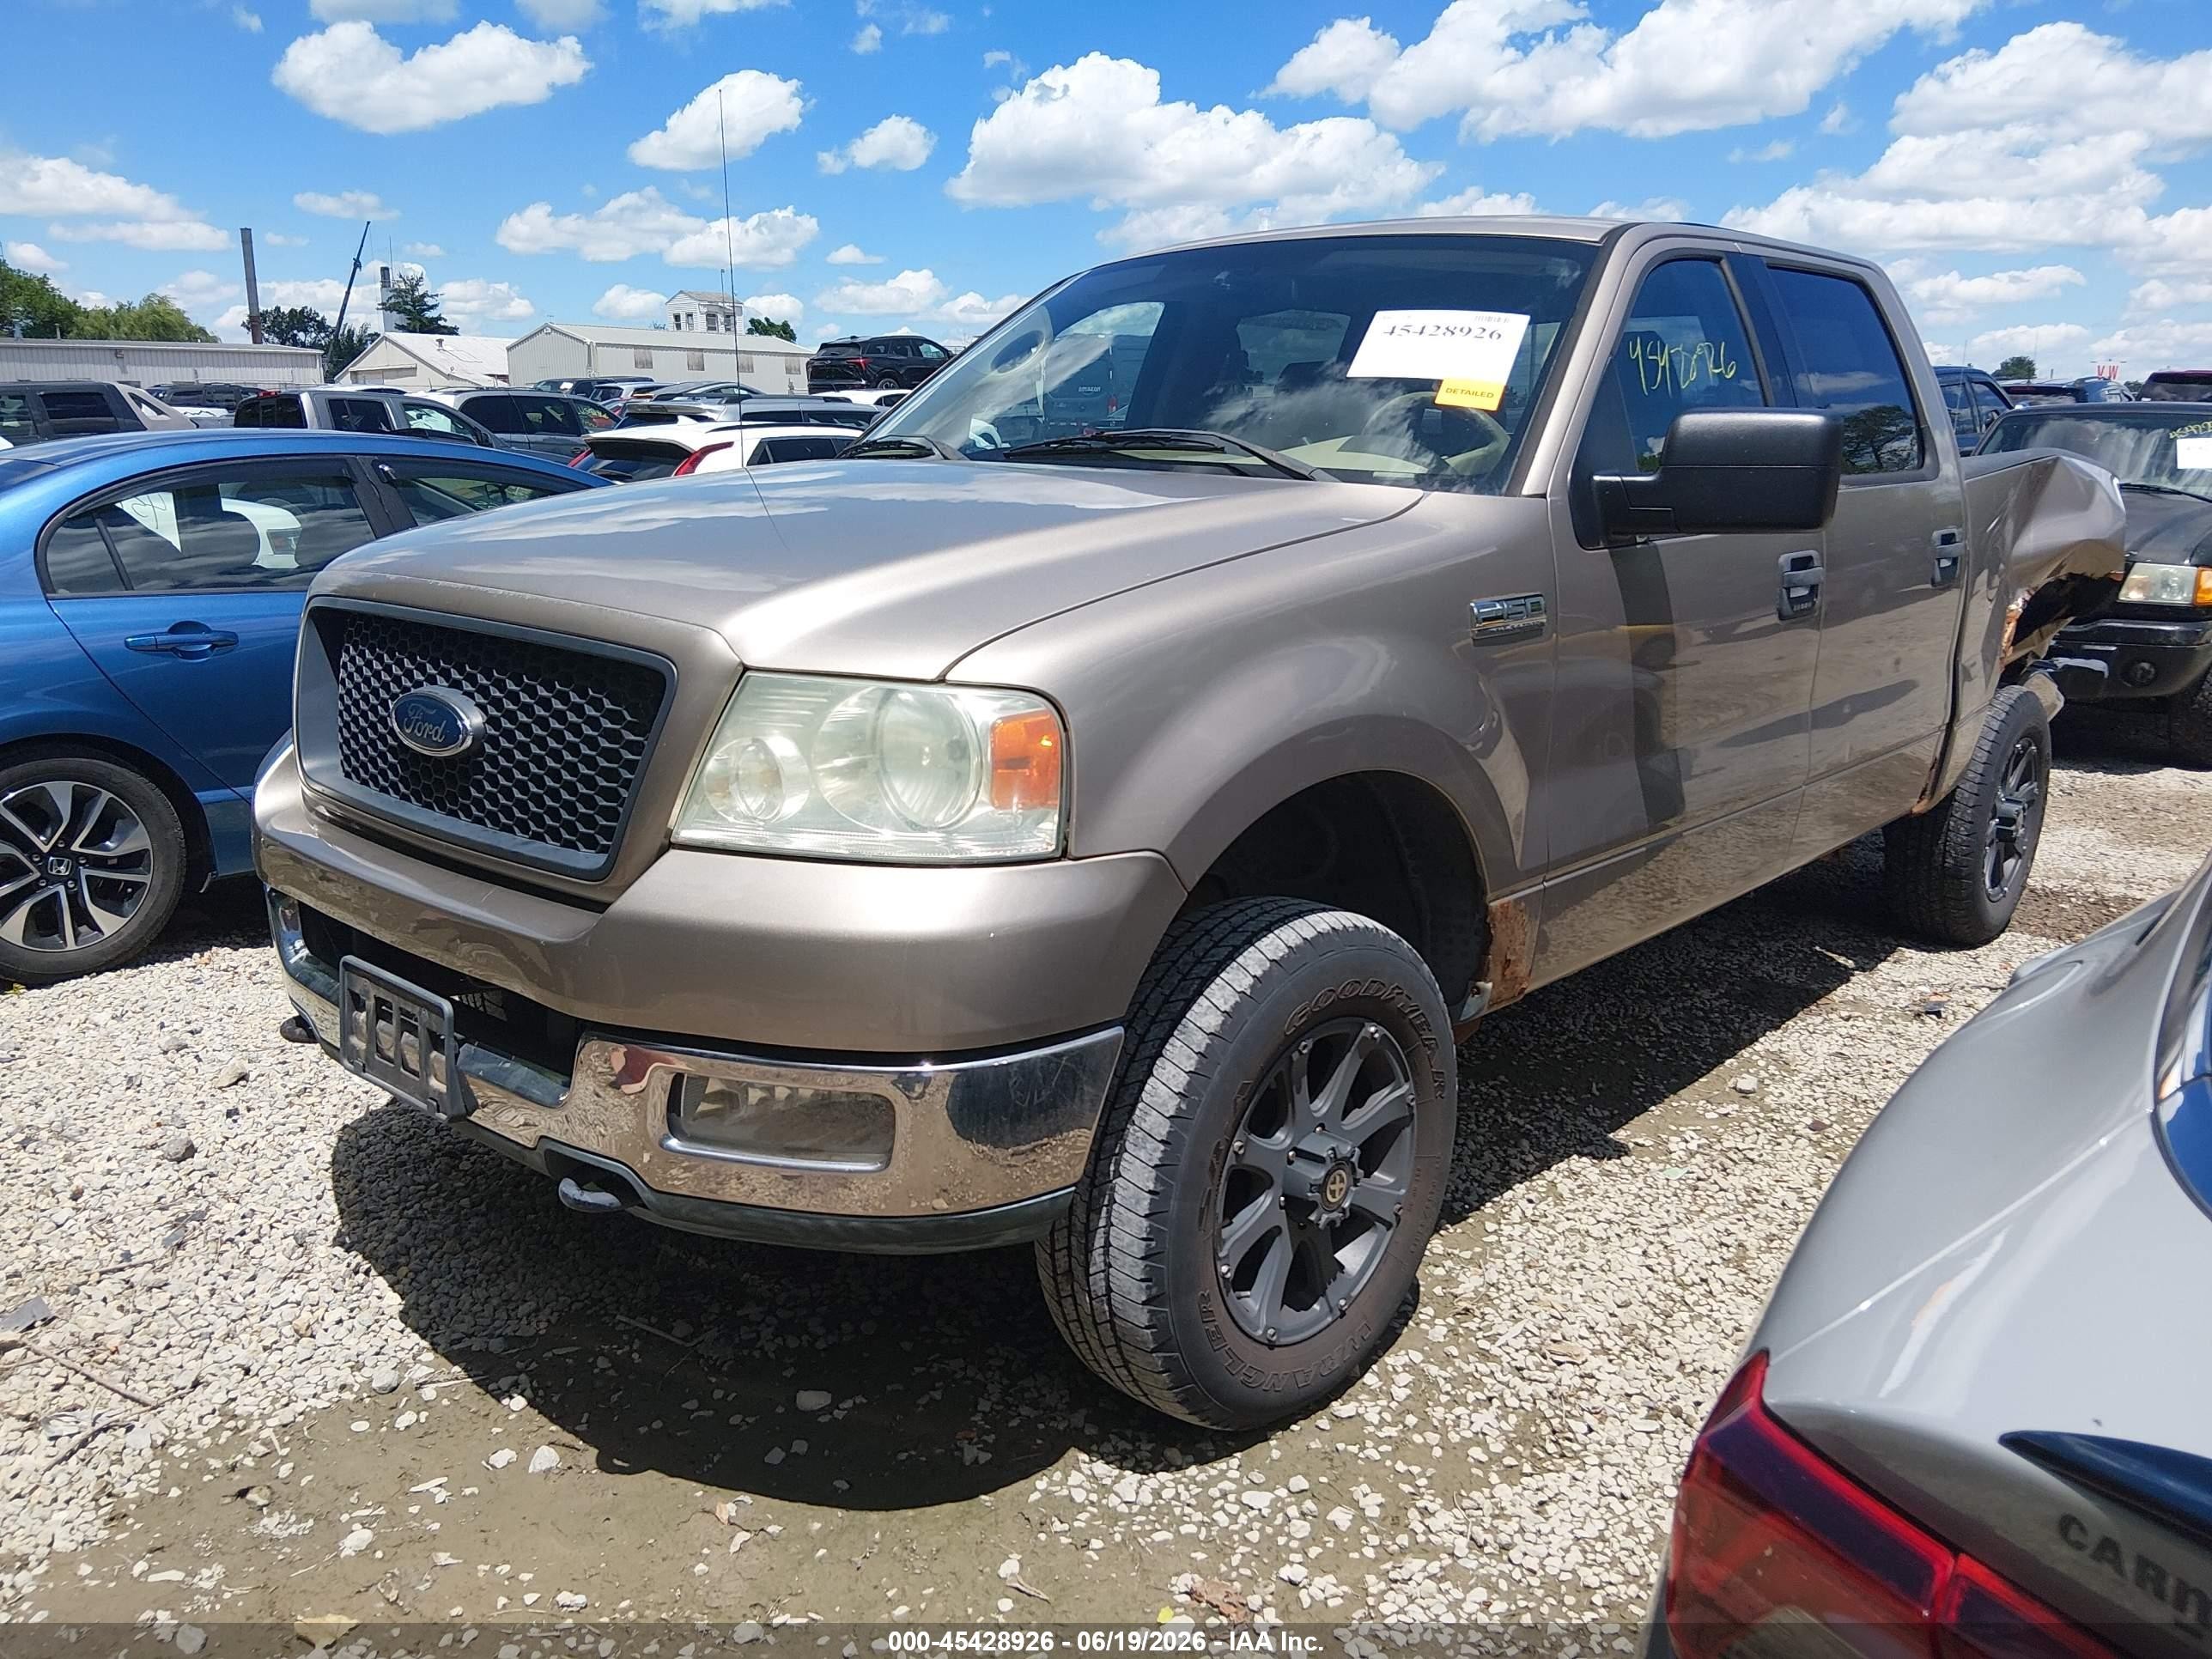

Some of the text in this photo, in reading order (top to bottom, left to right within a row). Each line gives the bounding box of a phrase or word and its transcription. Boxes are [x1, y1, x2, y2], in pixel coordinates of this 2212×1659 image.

[1383, 324, 1503, 341] 45428926
[1444, 386, 1495, 398] DETAILED
[403, 702, 448, 744] Ford
[1284, 977, 1445, 1100] GOODYEAR
[1197, 1289, 1373, 1393] WRANGLER
